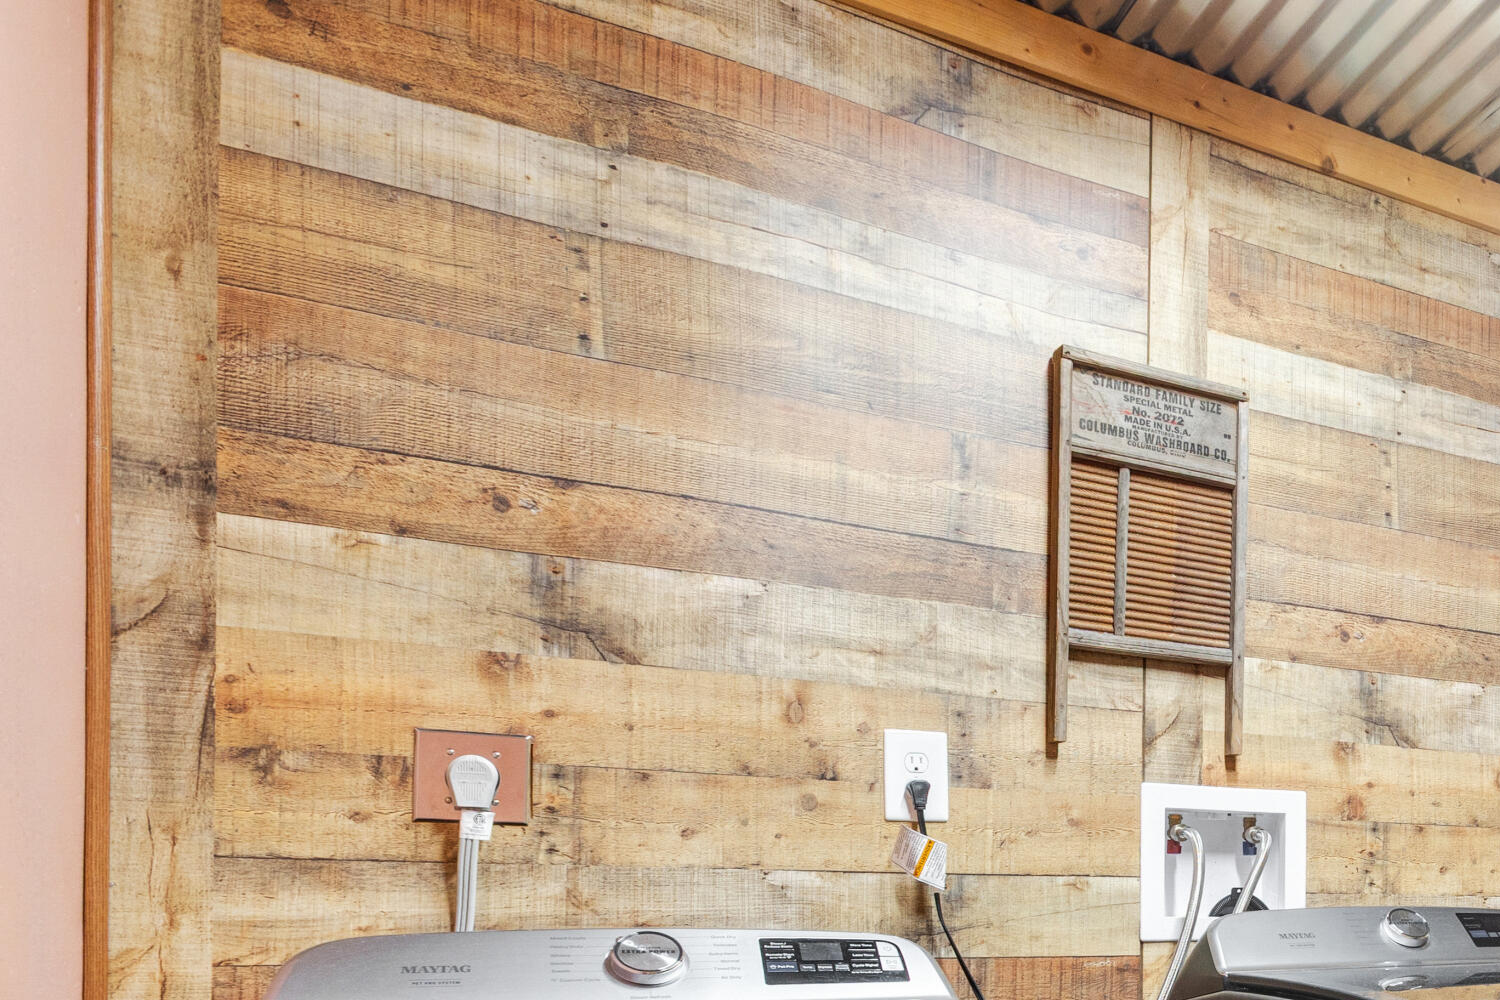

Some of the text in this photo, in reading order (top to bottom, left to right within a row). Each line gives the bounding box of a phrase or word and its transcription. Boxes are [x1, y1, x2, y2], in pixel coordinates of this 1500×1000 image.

[1092, 372, 1222, 415] STANDARD FAMILY SIZE
[1123, 394, 1194, 418] SPECIAL METAL
[1132, 406, 1185, 426] No. 2072
[1124, 414, 1192, 437] MADE IN U.S.A.
[1079, 417, 1231, 463] COLUMBUS WASHBOARD CO.
[400, 964, 472, 974] MAYTAG
